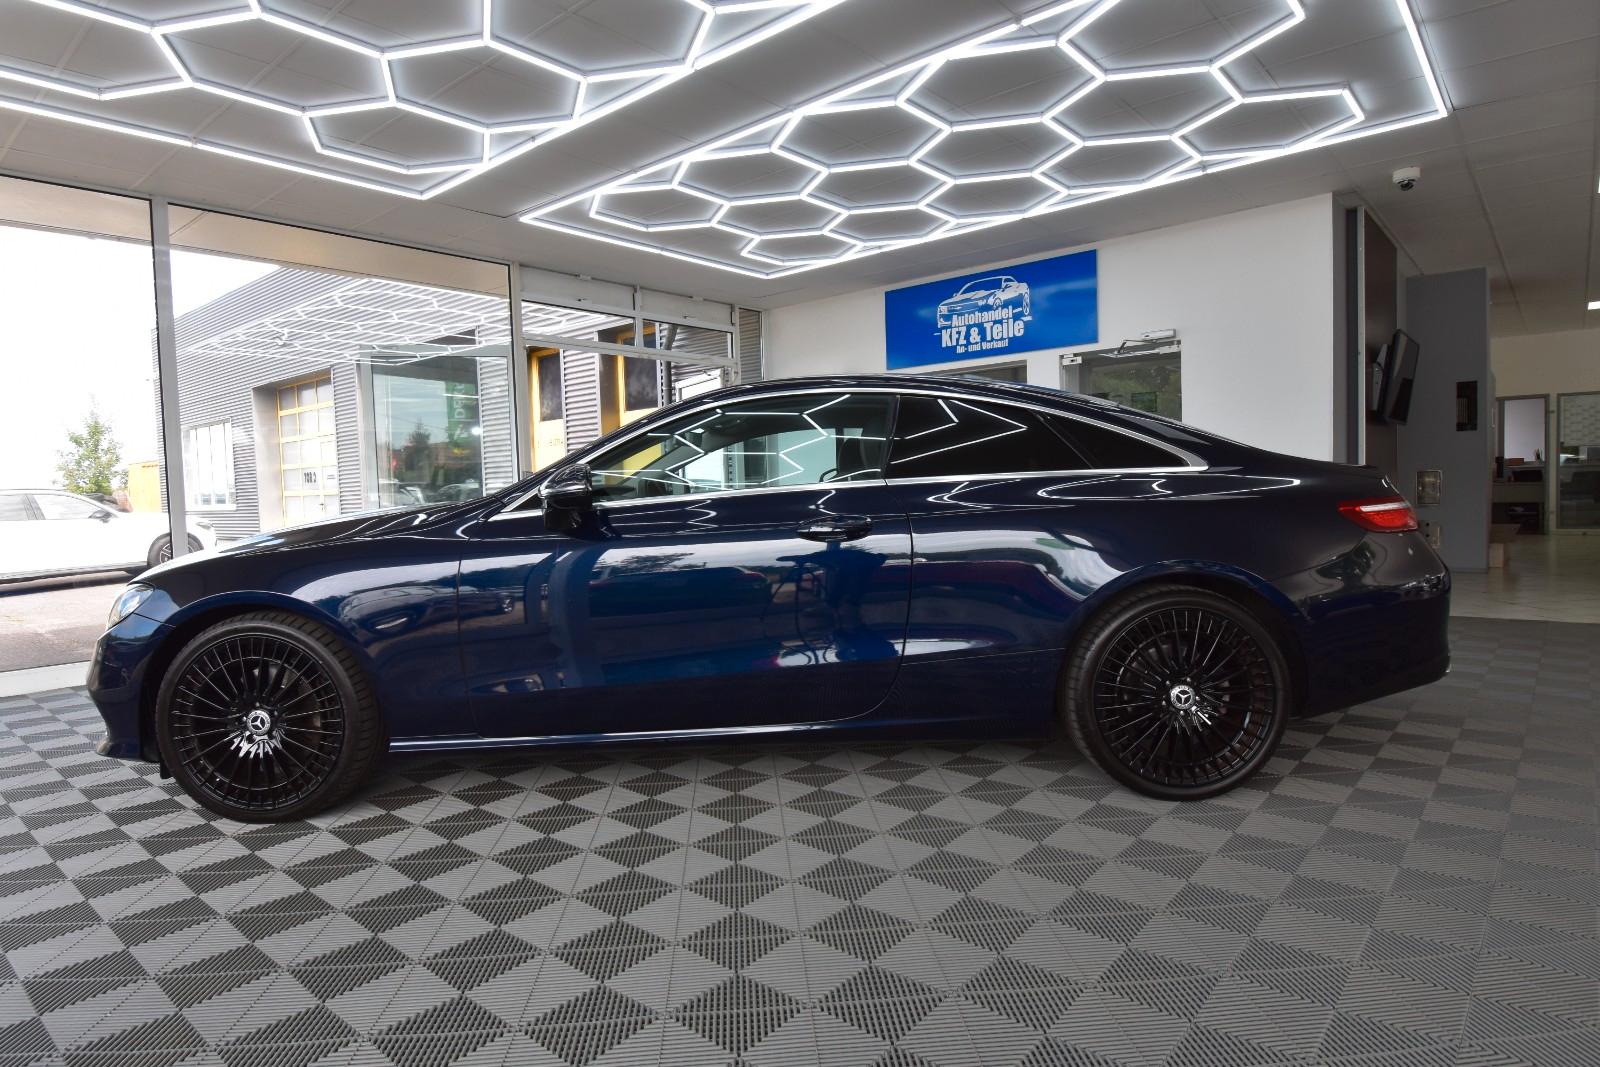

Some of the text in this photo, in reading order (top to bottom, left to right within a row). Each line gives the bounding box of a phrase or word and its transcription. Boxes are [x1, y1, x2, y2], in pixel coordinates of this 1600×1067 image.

[951, 305, 1013, 328] Autohandel
[941, 318, 1025, 348] KFZ & Teile
[968, 343, 981, 352] und
[981, 339, 1009, 350] Verkauf
